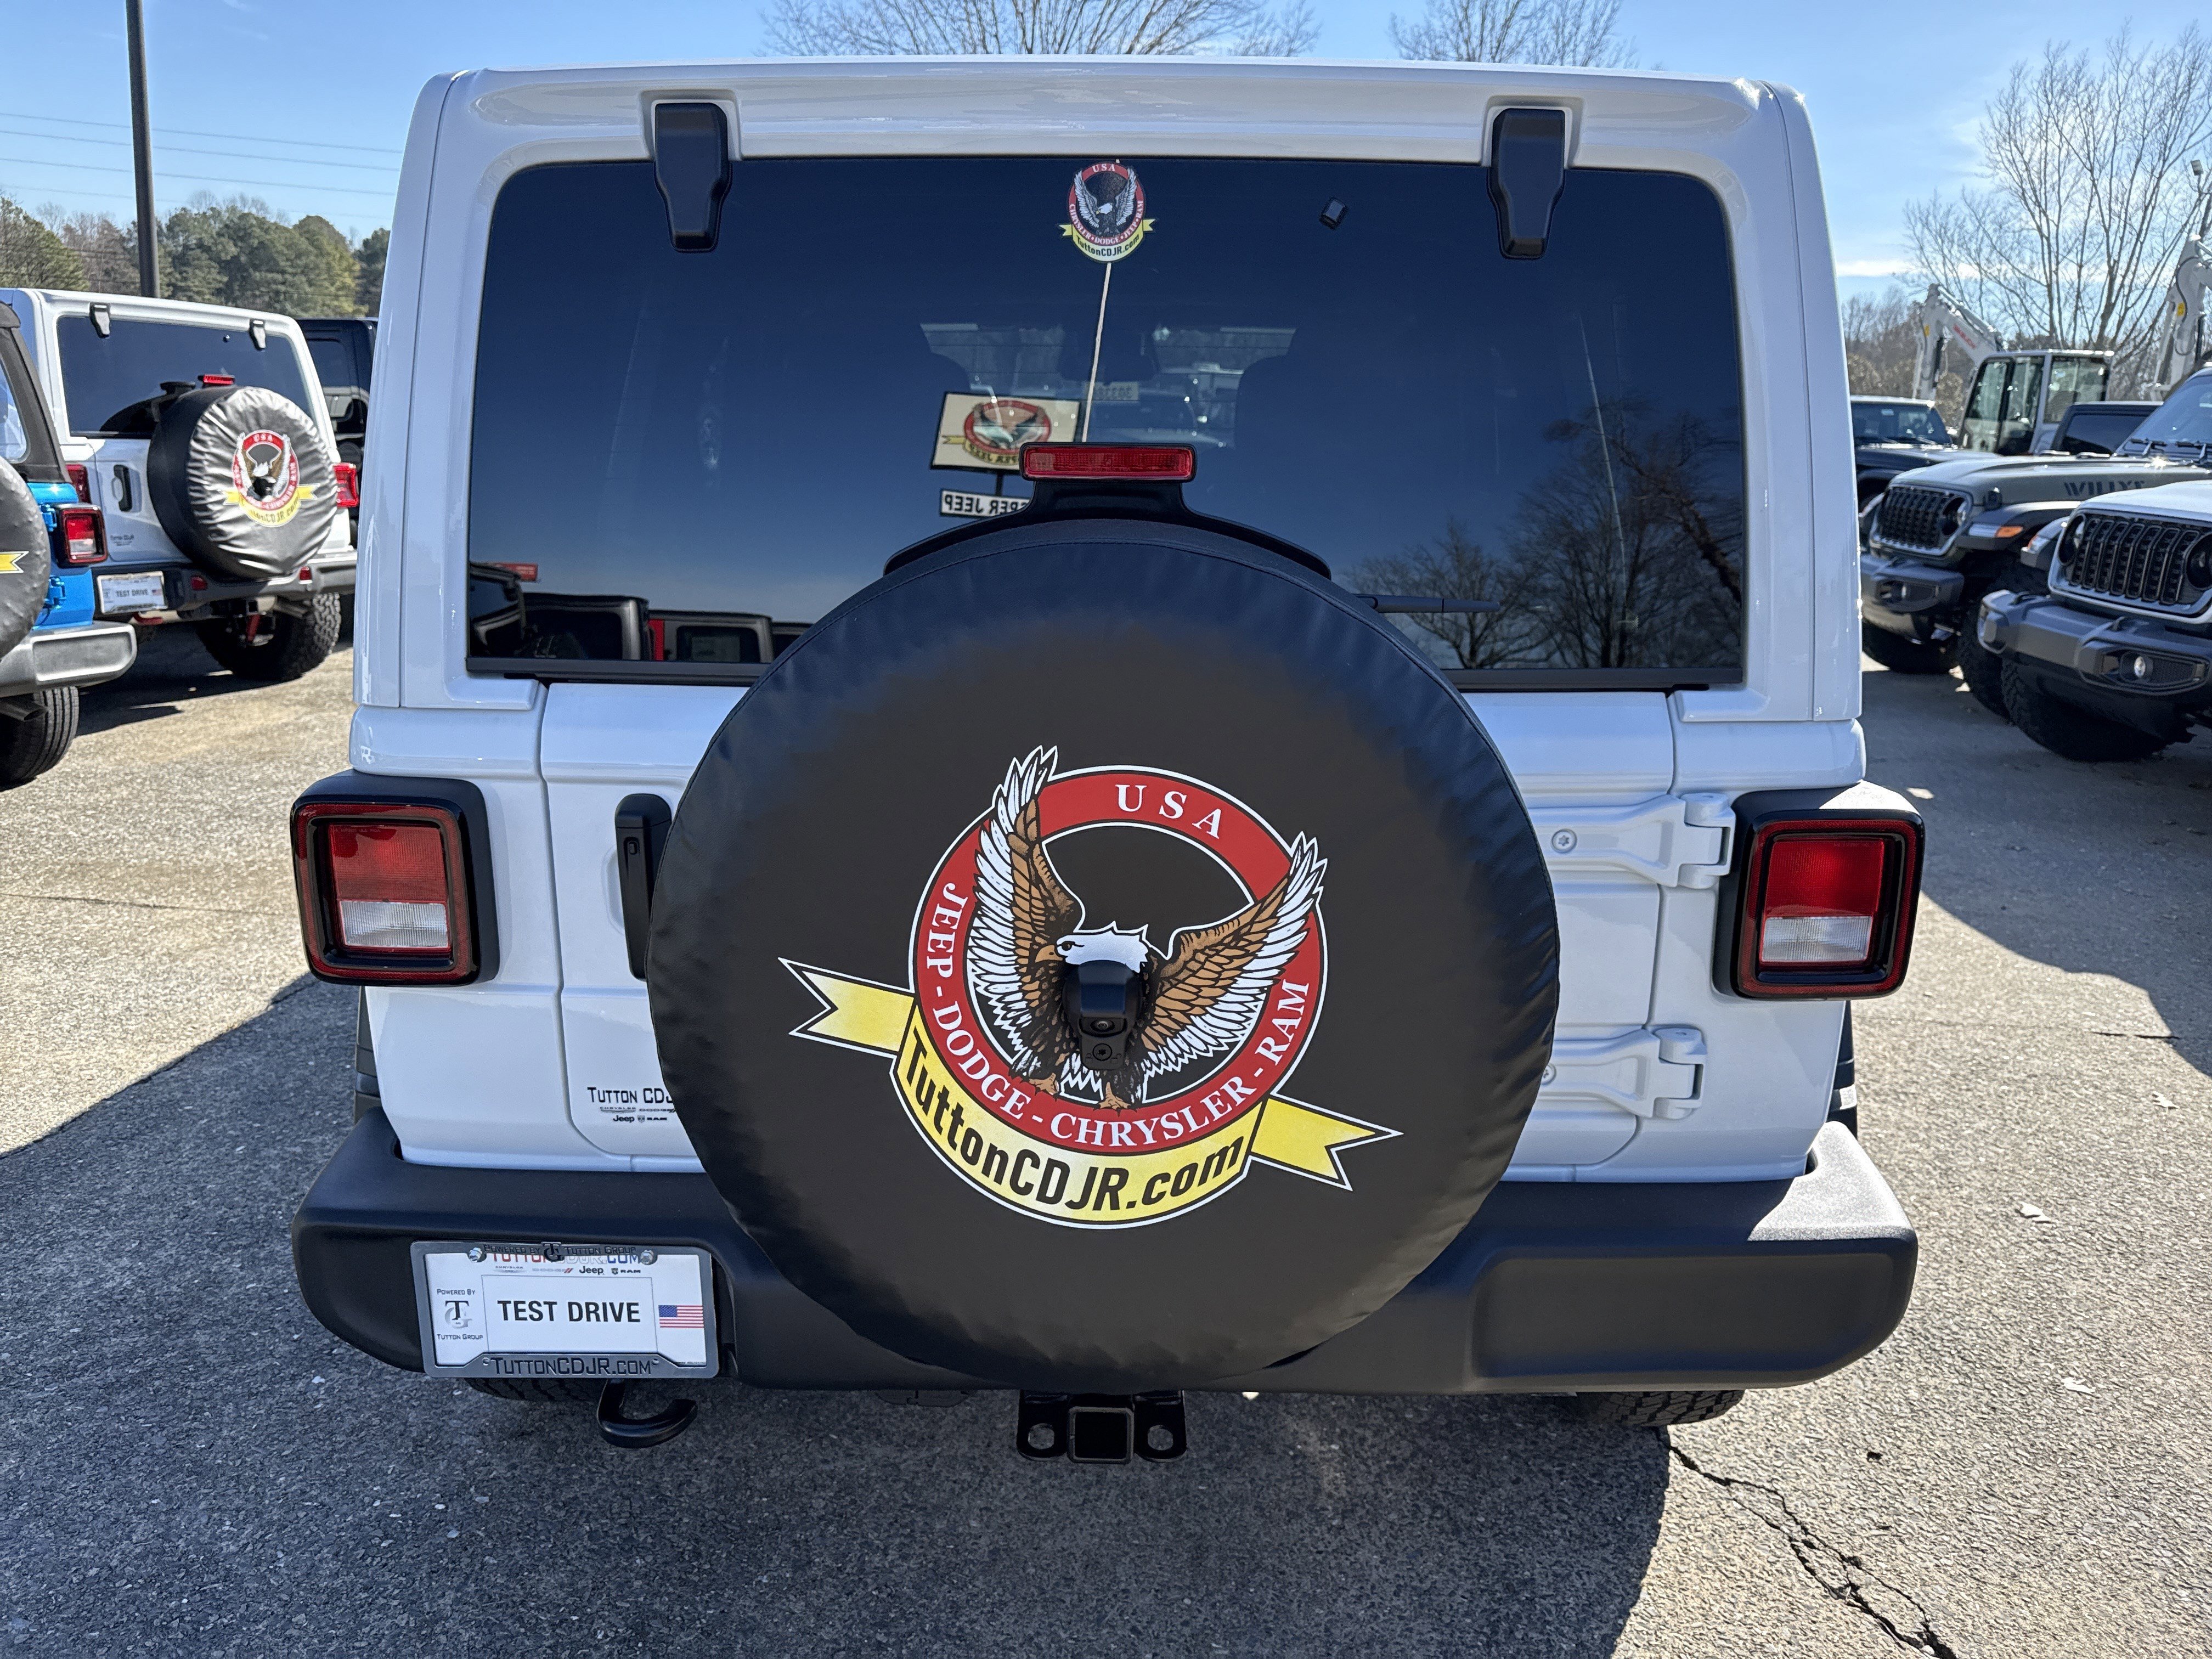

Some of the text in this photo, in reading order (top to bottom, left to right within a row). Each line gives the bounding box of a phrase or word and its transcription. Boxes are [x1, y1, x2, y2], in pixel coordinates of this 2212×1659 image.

[1092, 164, 1115, 173] USA
[1136, 201, 1144, 218] RAM
[1076, 234, 1139, 257] TuttonCDJR.com
[253, 433, 273, 442] USA
[1116, 784, 1222, 839] USA
[926, 883, 1310, 1148] JEEP DODGE CHRYSLER RAM
[587, 1087, 637, 1103] TUTTON
[910, 1039, 1244, 1211] TuttonCDJR.com
[604, 1246, 636, 1254] GROUP
[579, 1266, 604, 1276] Jeep
[497, 1300, 641, 1323] TEST DRIVE
